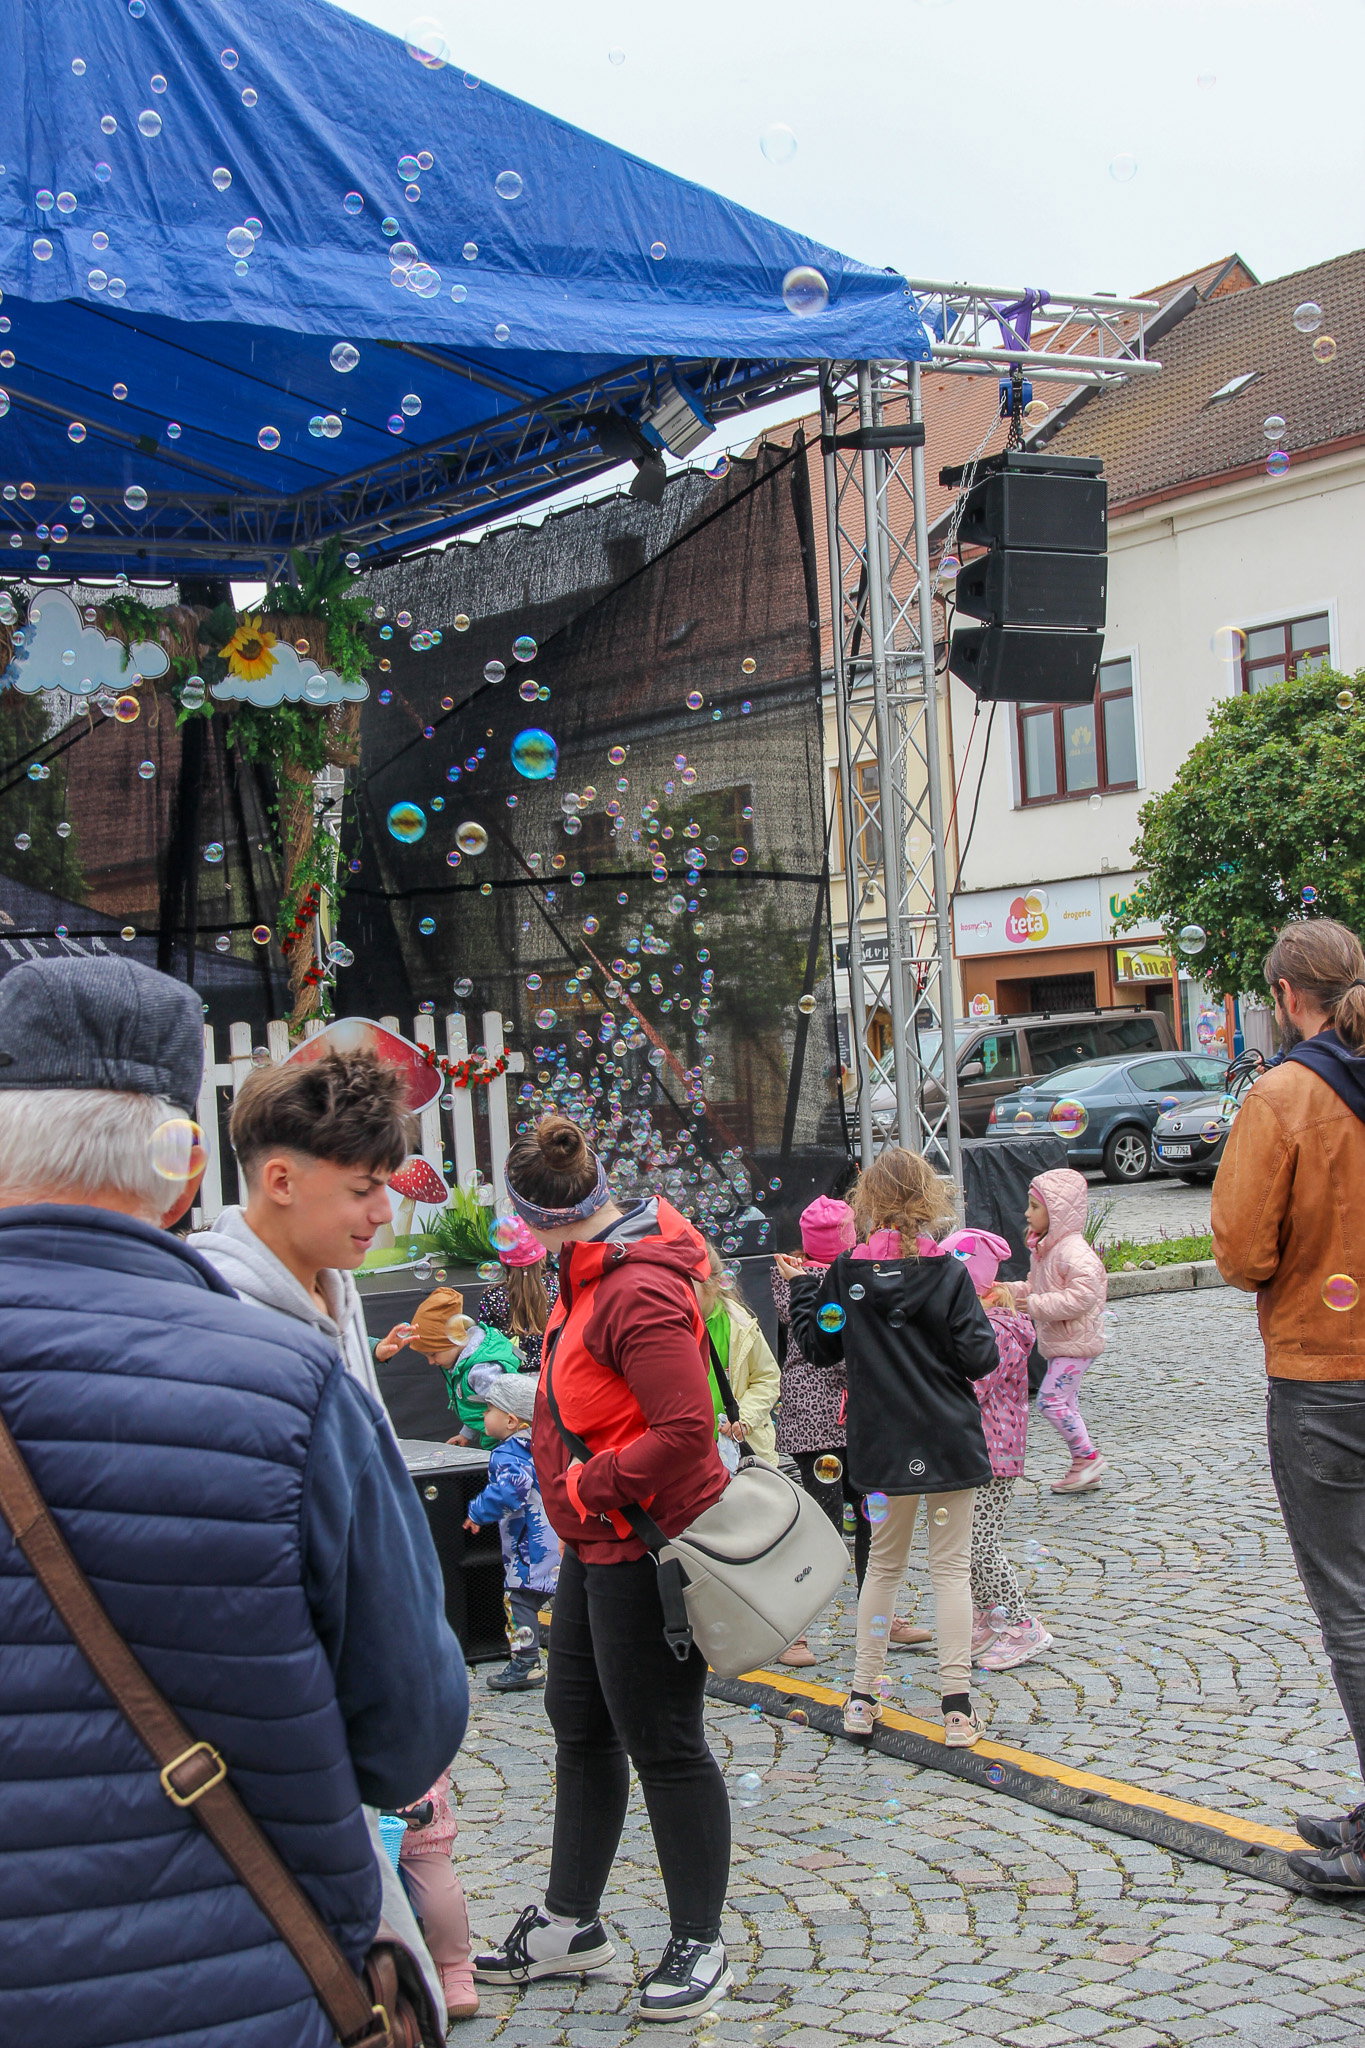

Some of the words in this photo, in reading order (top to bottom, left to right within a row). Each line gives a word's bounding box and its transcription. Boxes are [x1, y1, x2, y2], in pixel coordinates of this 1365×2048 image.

[1063, 909, 1092, 921] drogerie
[1010, 913, 1045, 934] teta
[976, 1003, 989, 1012] teta
